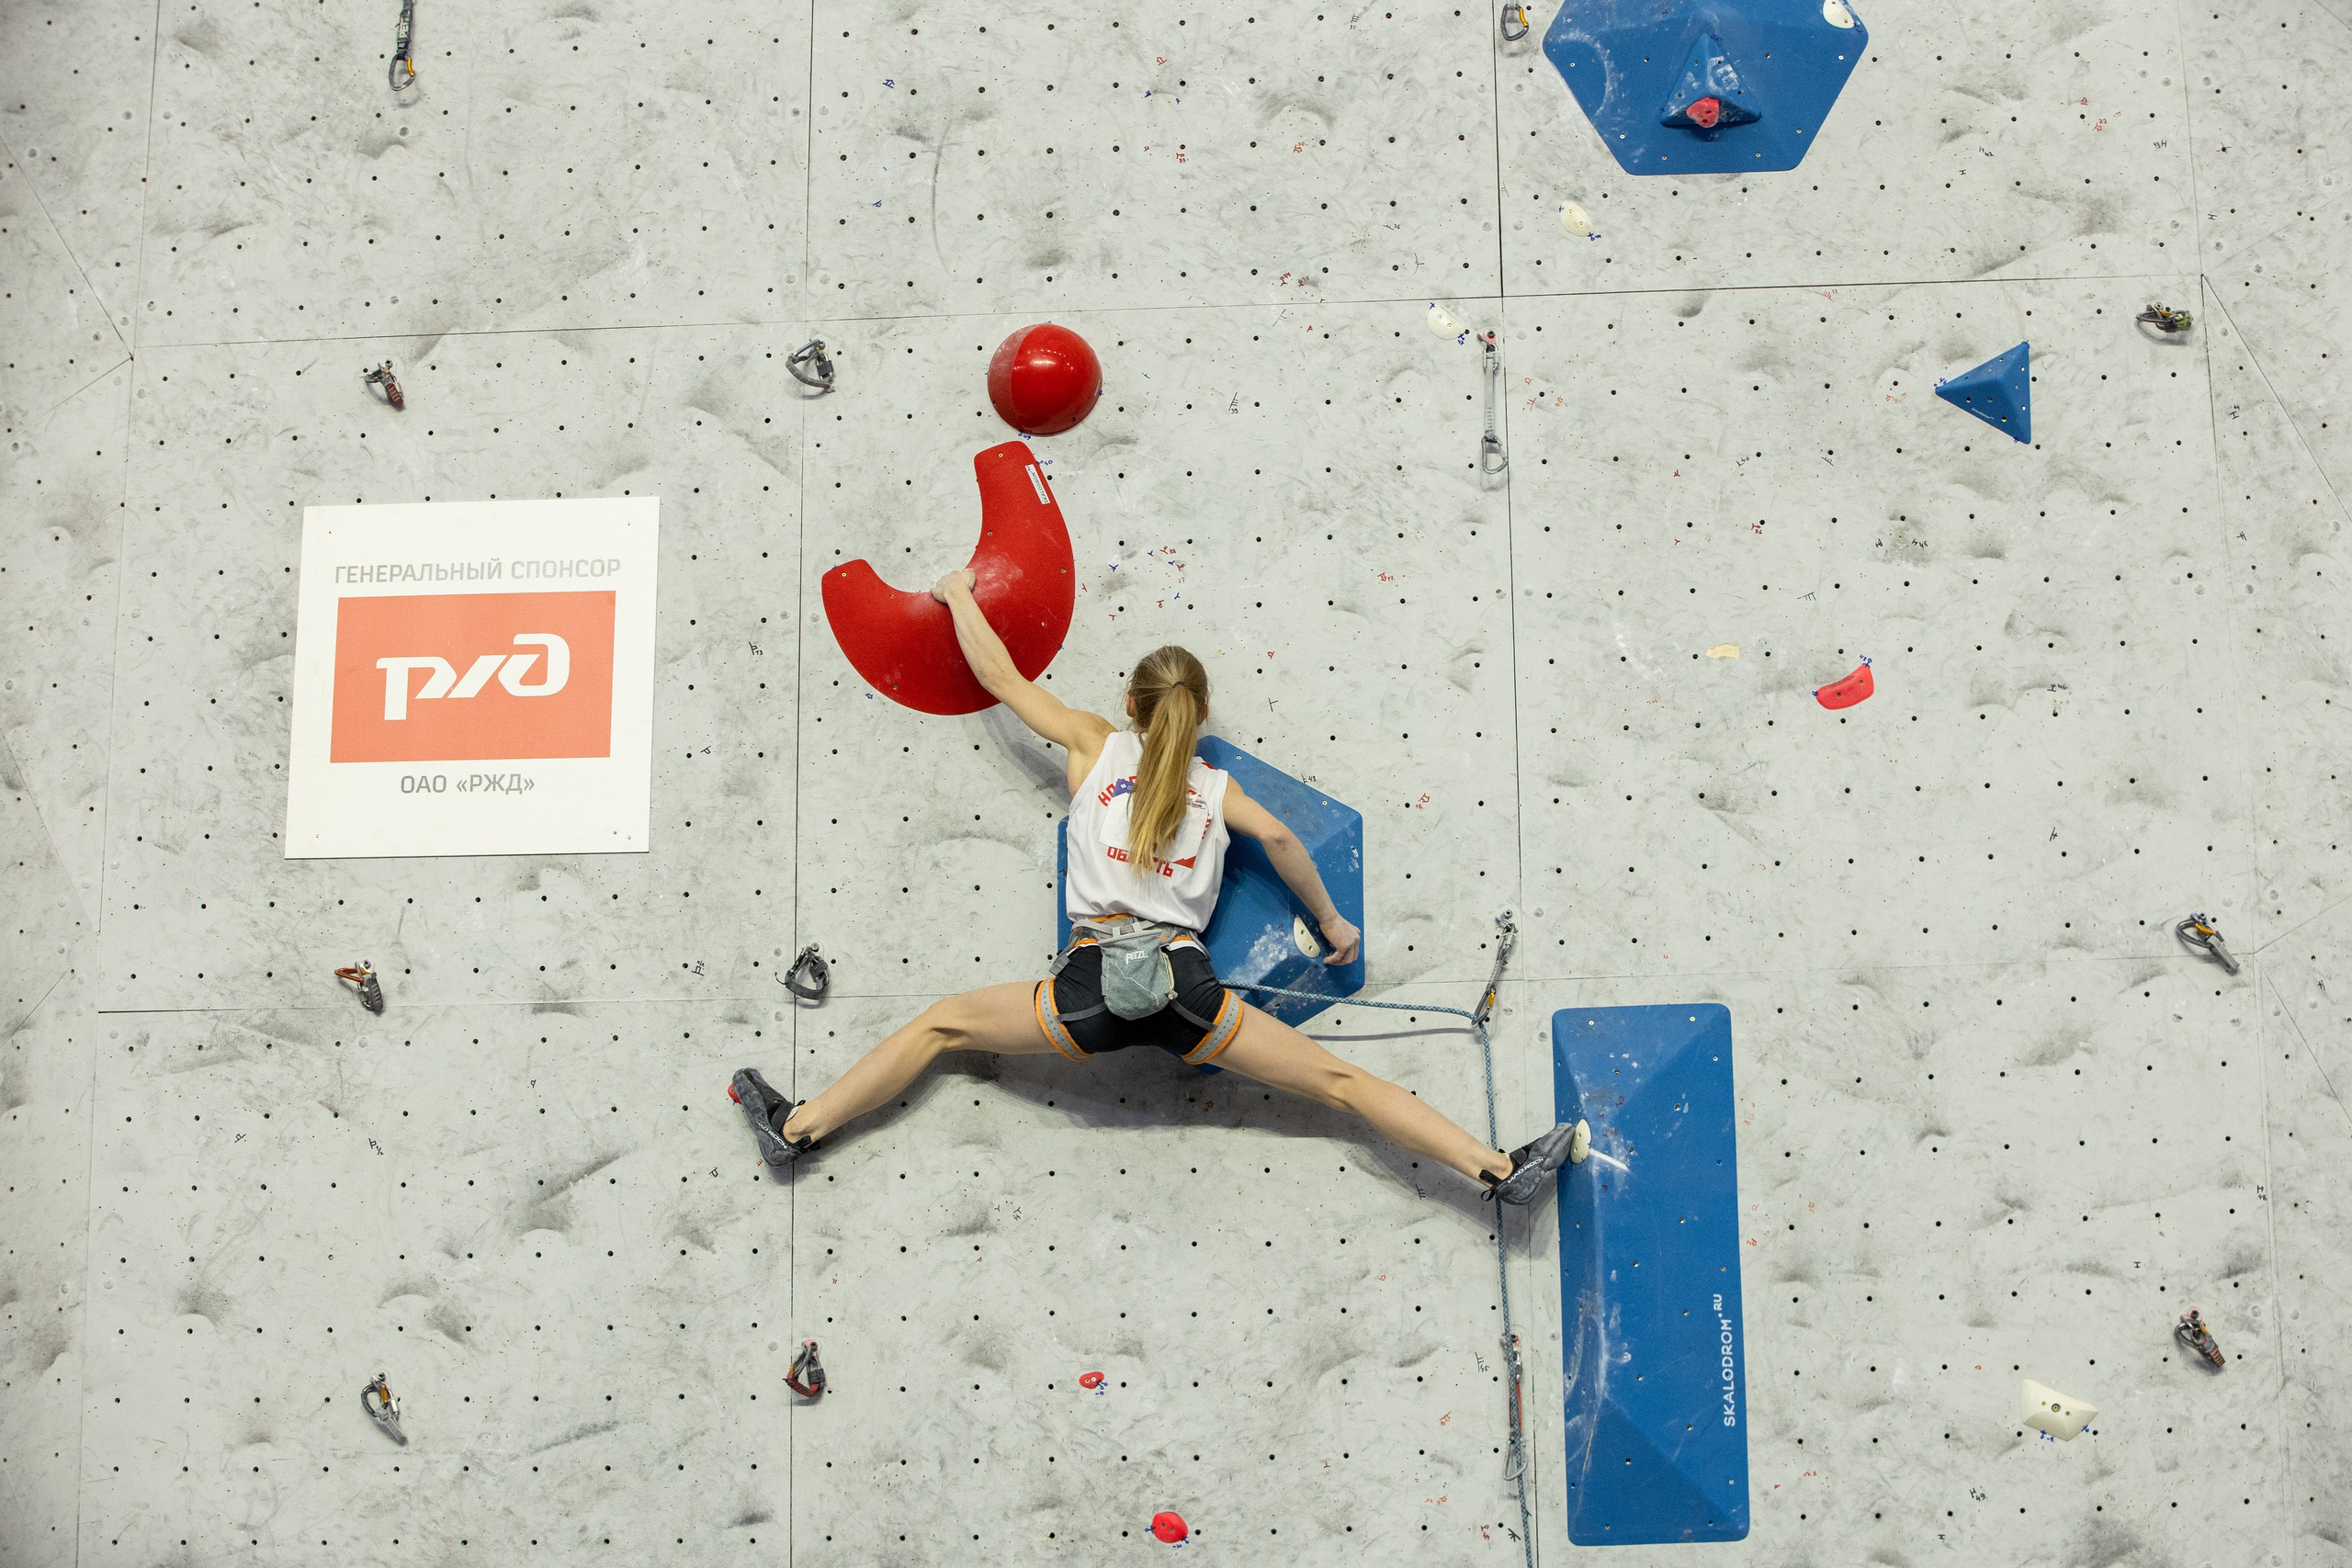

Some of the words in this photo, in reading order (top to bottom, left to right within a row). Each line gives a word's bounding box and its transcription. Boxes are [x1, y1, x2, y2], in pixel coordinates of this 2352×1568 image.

[334, 557, 503, 583] ГЕНЕРАЛЬНЫЙ
[511, 558, 621, 580] СПОНСОР
[401, 774, 447, 794] ОАО
[456, 773, 535, 795] «РЖД»
[767, 1130, 787, 1149] ROCK
[1507, 1168, 1524, 1184] MAD
[1524, 1156, 1544, 1171] ROCK
